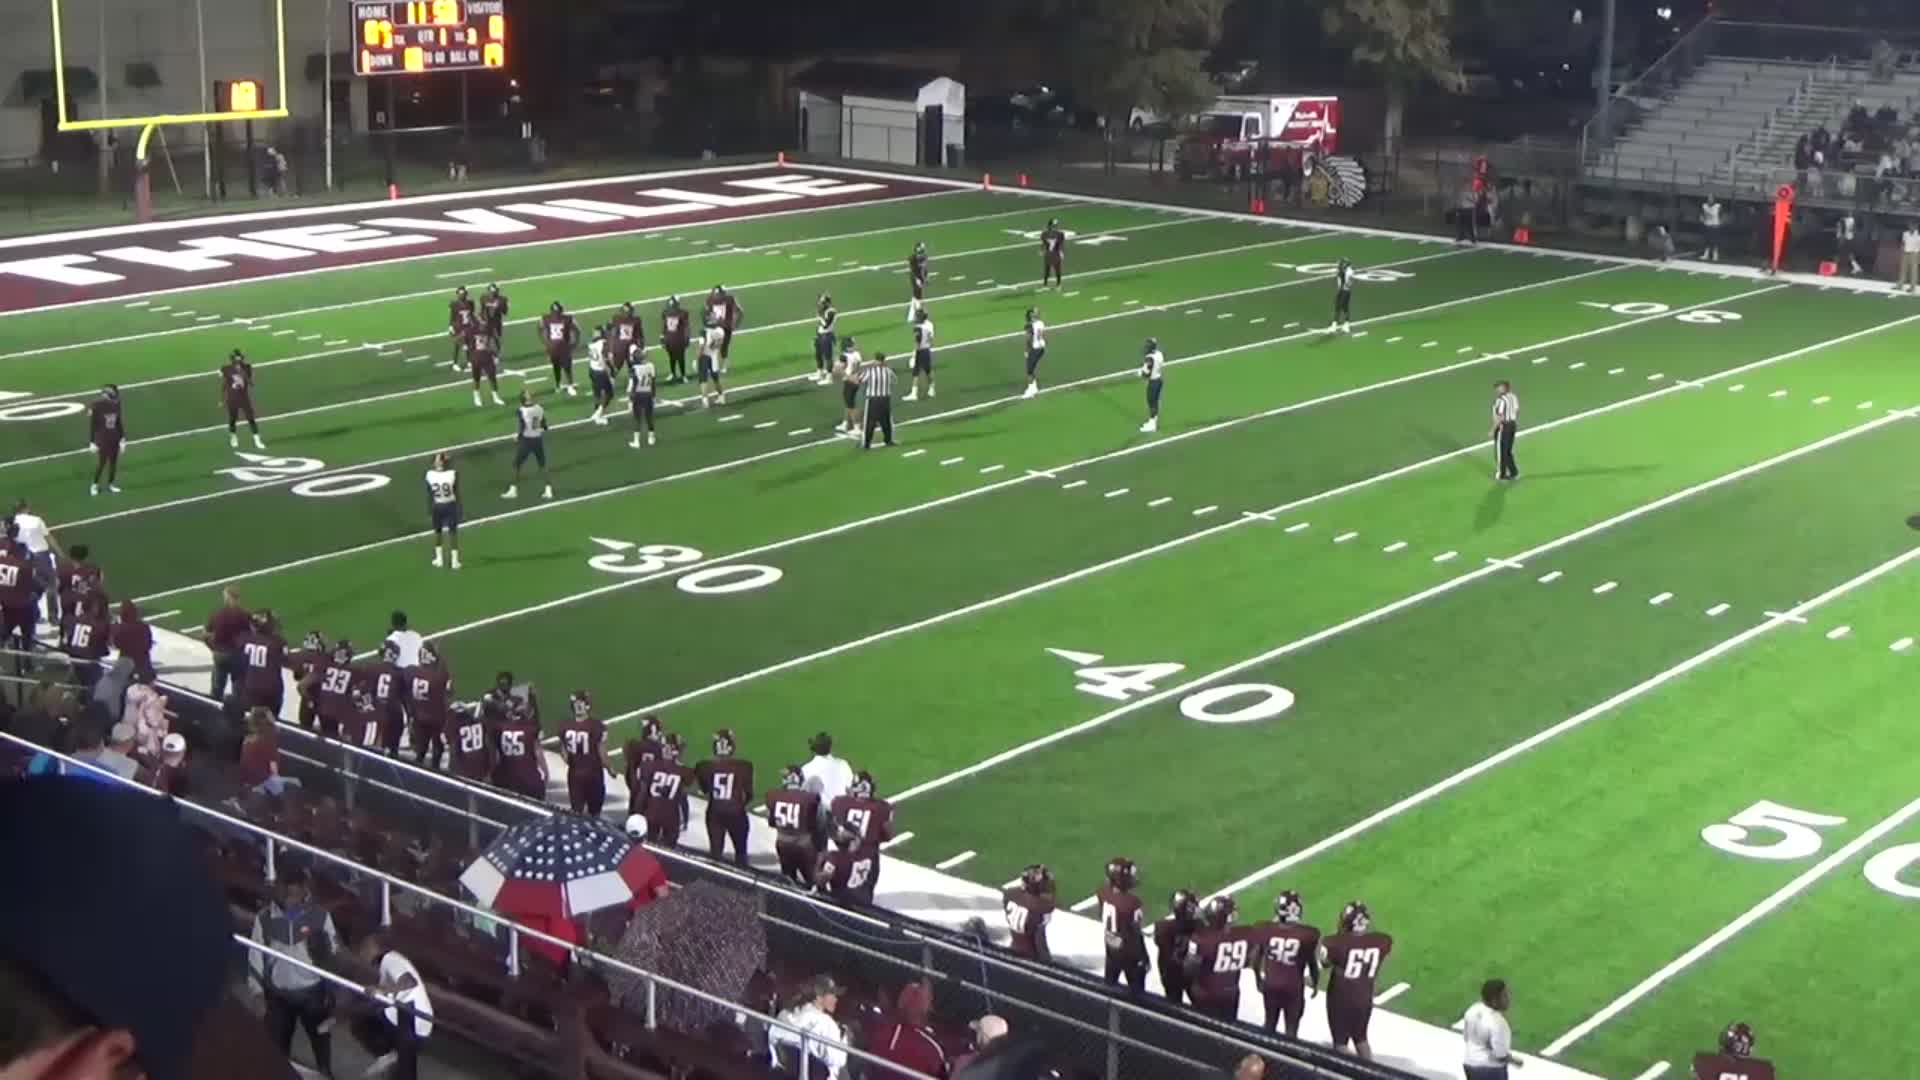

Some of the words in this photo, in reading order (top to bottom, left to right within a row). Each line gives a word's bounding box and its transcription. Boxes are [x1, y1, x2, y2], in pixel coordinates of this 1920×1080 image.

[358, 5, 388, 18] HOME
[432, 482, 451, 497] 29
[71, 623, 92, 648] 16
[322, 667, 351, 694] 33
[377, 673, 391, 699] 6
[412, 677, 429, 700] 12
[460, 723, 483, 752] 28
[501, 730, 525, 756] 65
[565, 729, 590, 755] 37
[650, 771, 681, 799] 27
[713, 773, 734, 801] 51
[774, 800, 801, 830] 54
[1214, 939, 1248, 973] 69
[1268, 936, 1300, 966] 32
[1344, 947, 1380, 979] 67
